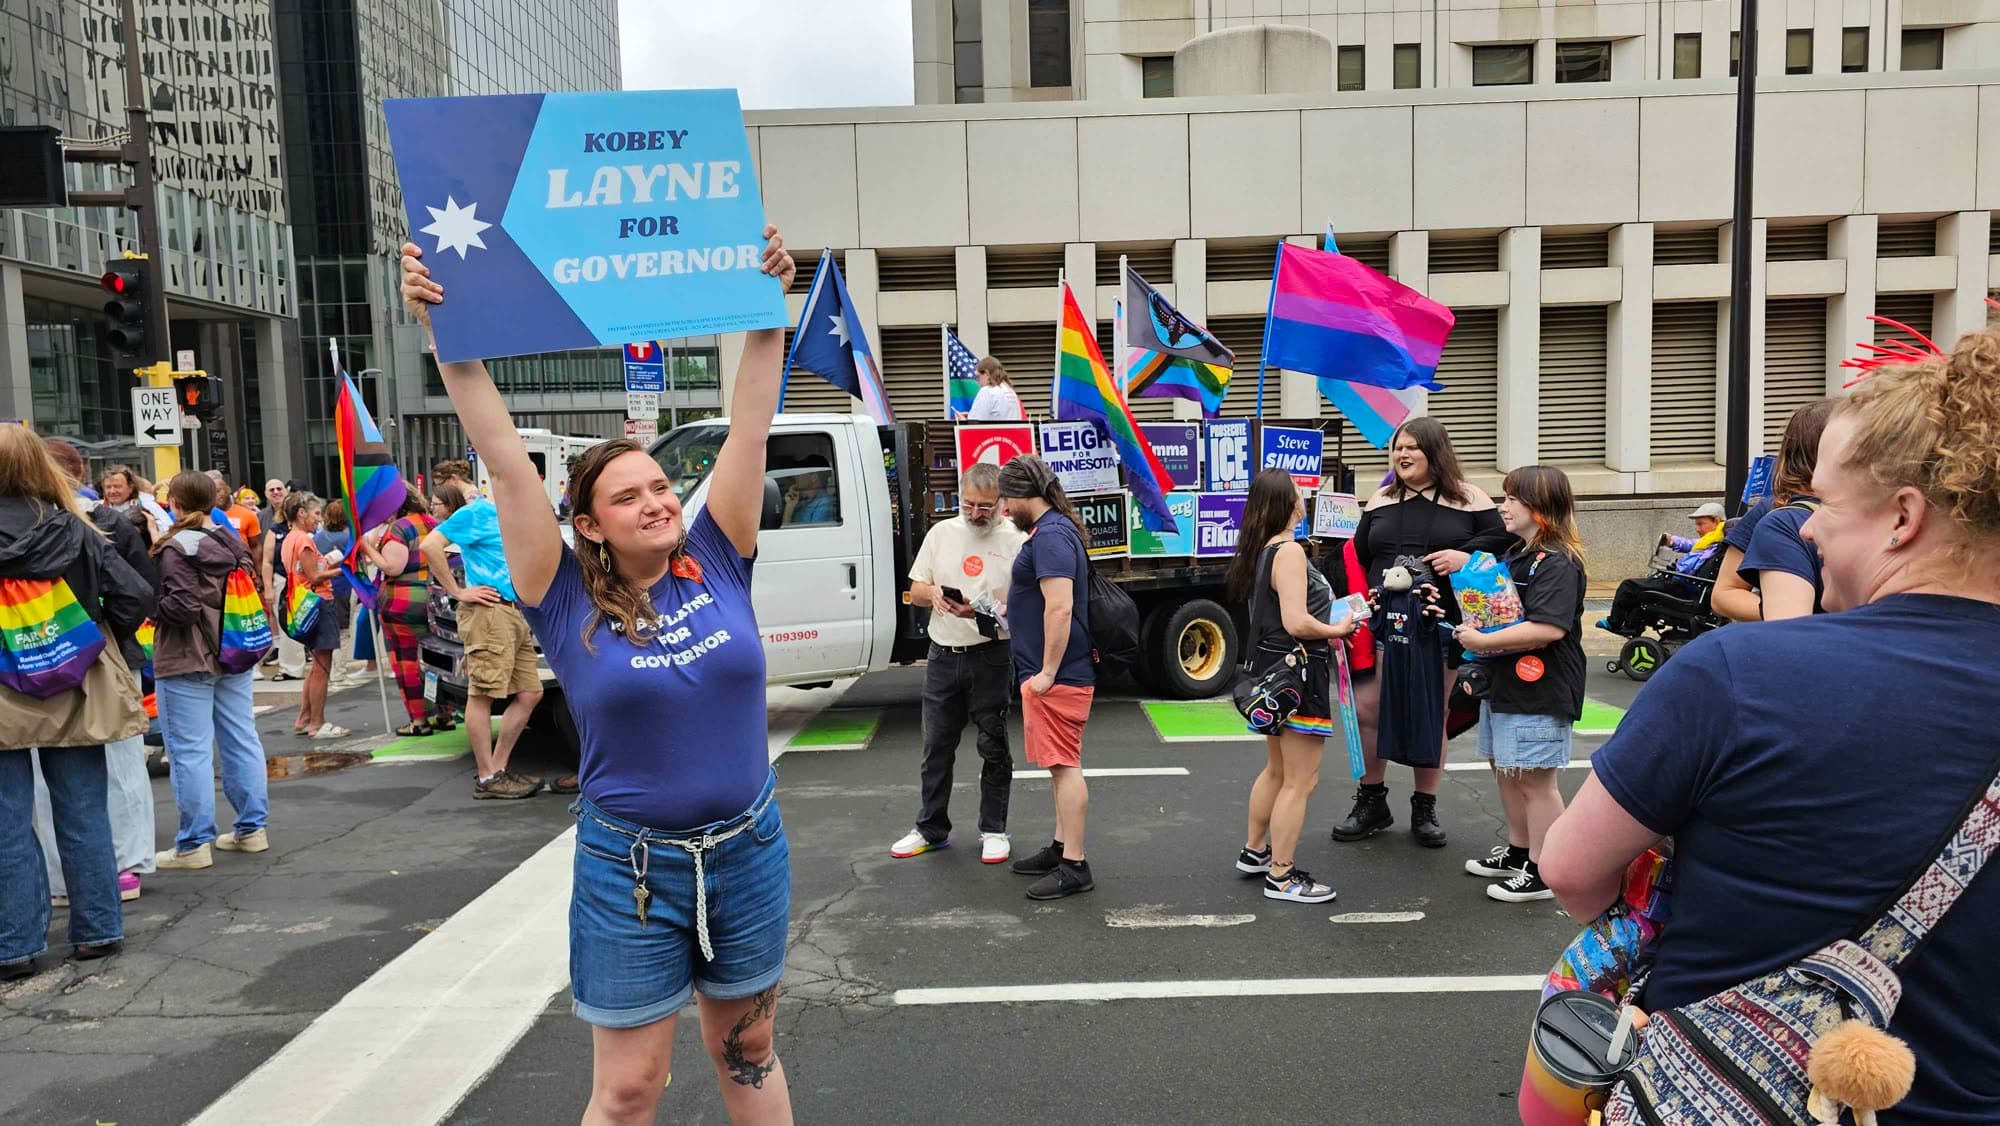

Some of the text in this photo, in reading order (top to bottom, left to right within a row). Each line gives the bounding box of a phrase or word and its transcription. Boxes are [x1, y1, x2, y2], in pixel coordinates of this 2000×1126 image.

[584, 129, 688, 153] KOBEY
[545, 161, 740, 209] LAYNE
[618, 215, 679, 238] FOR
[553, 244, 762, 285] GOVERNOR
[141, 392, 171, 405] ONE
[141, 407, 172, 421] WAY
[1043, 429, 1112, 453] LEIGH
[1148, 442, 1189, 457] mma
[1277, 434, 1310, 450] Steve
[1046, 456, 1116, 473] MINNESOTA
[1210, 436, 1249, 482] ICE
[1264, 452, 1320, 472] SIMON
[1073, 503, 1118, 525] RIN
[1320, 500, 1345, 514] Alex
[664, 592, 714, 627] LAYNE
[656, 626, 692, 648] FOR
[769, 630, 818, 643] 1093909
[630, 629, 732, 669] GOVERNOR
